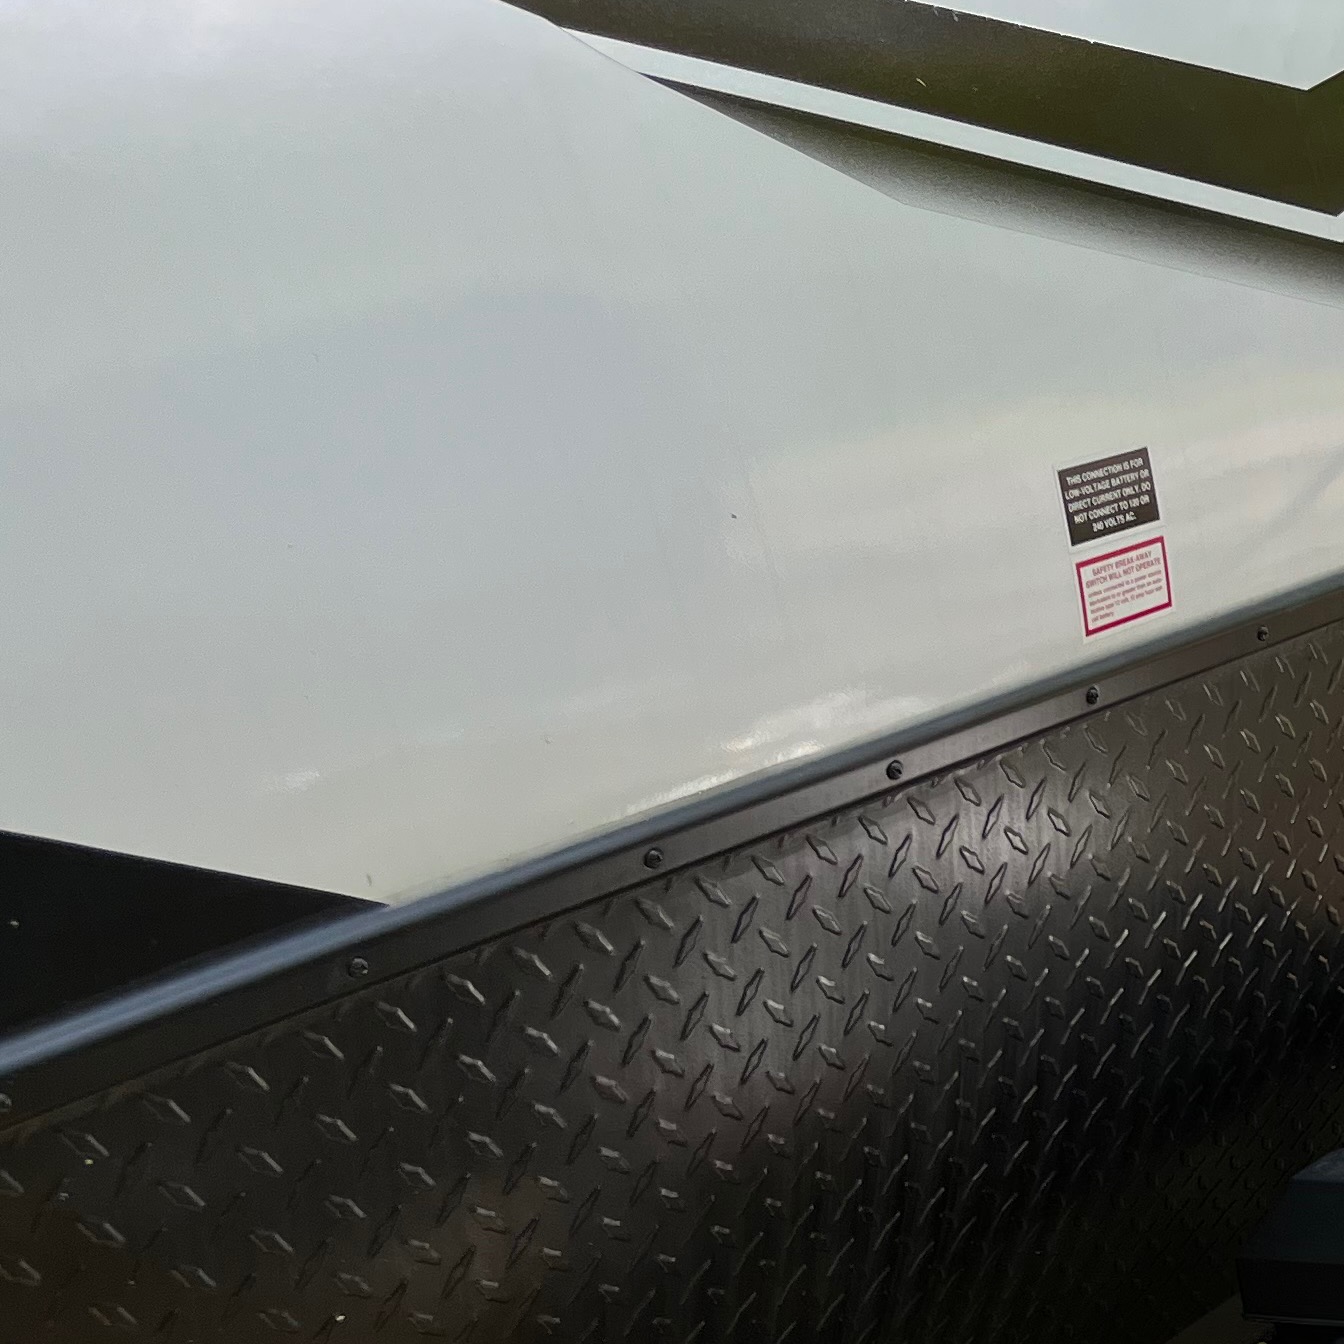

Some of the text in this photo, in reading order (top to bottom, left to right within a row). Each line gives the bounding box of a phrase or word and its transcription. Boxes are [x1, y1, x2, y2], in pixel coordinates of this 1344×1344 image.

[1066, 457, 1143, 486] THIS CONNECTION IS FOR
[1110, 471, 1139, 486] BATTERY
[1139, 468, 1149, 478] OR
[1067, 497, 1091, 512] DIRECT
[1091, 489, 1121, 505] CURRENT
[1140, 480, 1151, 491] DO
[1073, 512, 1087, 524] NOT
[1088, 503, 1118, 519] CONNECT
[1119, 500, 1128, 510] TO
[1139, 494, 1149, 504] OR
[1103, 514, 1125, 528] VOLTS
[1085, 556, 1161, 588] SWITCH WILL NOT OPERATE
[1092, 563, 1113, 576] SAFETY
